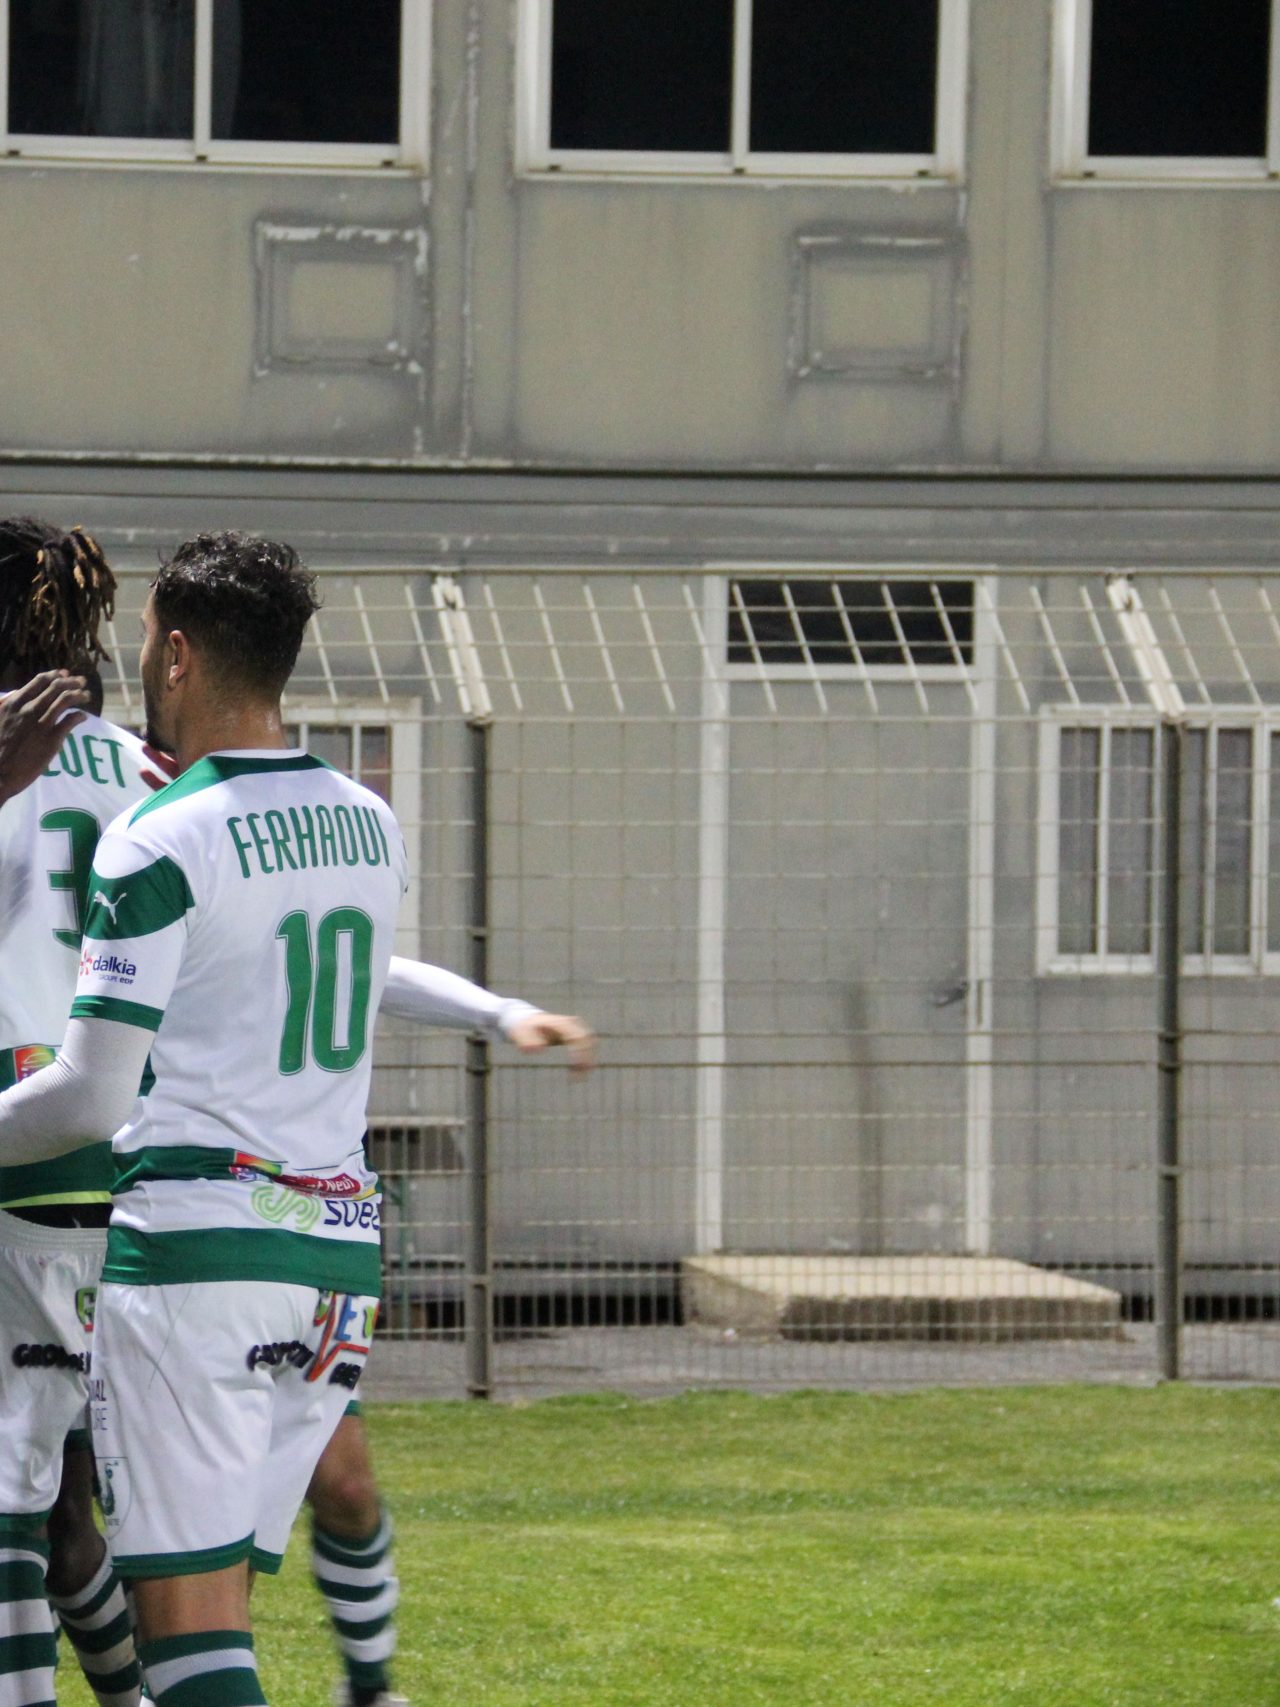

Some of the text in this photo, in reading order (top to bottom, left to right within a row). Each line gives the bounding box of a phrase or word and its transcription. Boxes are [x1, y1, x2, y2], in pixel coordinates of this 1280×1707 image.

[39, 807, 101, 953] 3
[227, 804, 390, 879] FERHAOUI
[92, 955, 136, 976] dalkia
[275, 905, 375, 1077] 10
